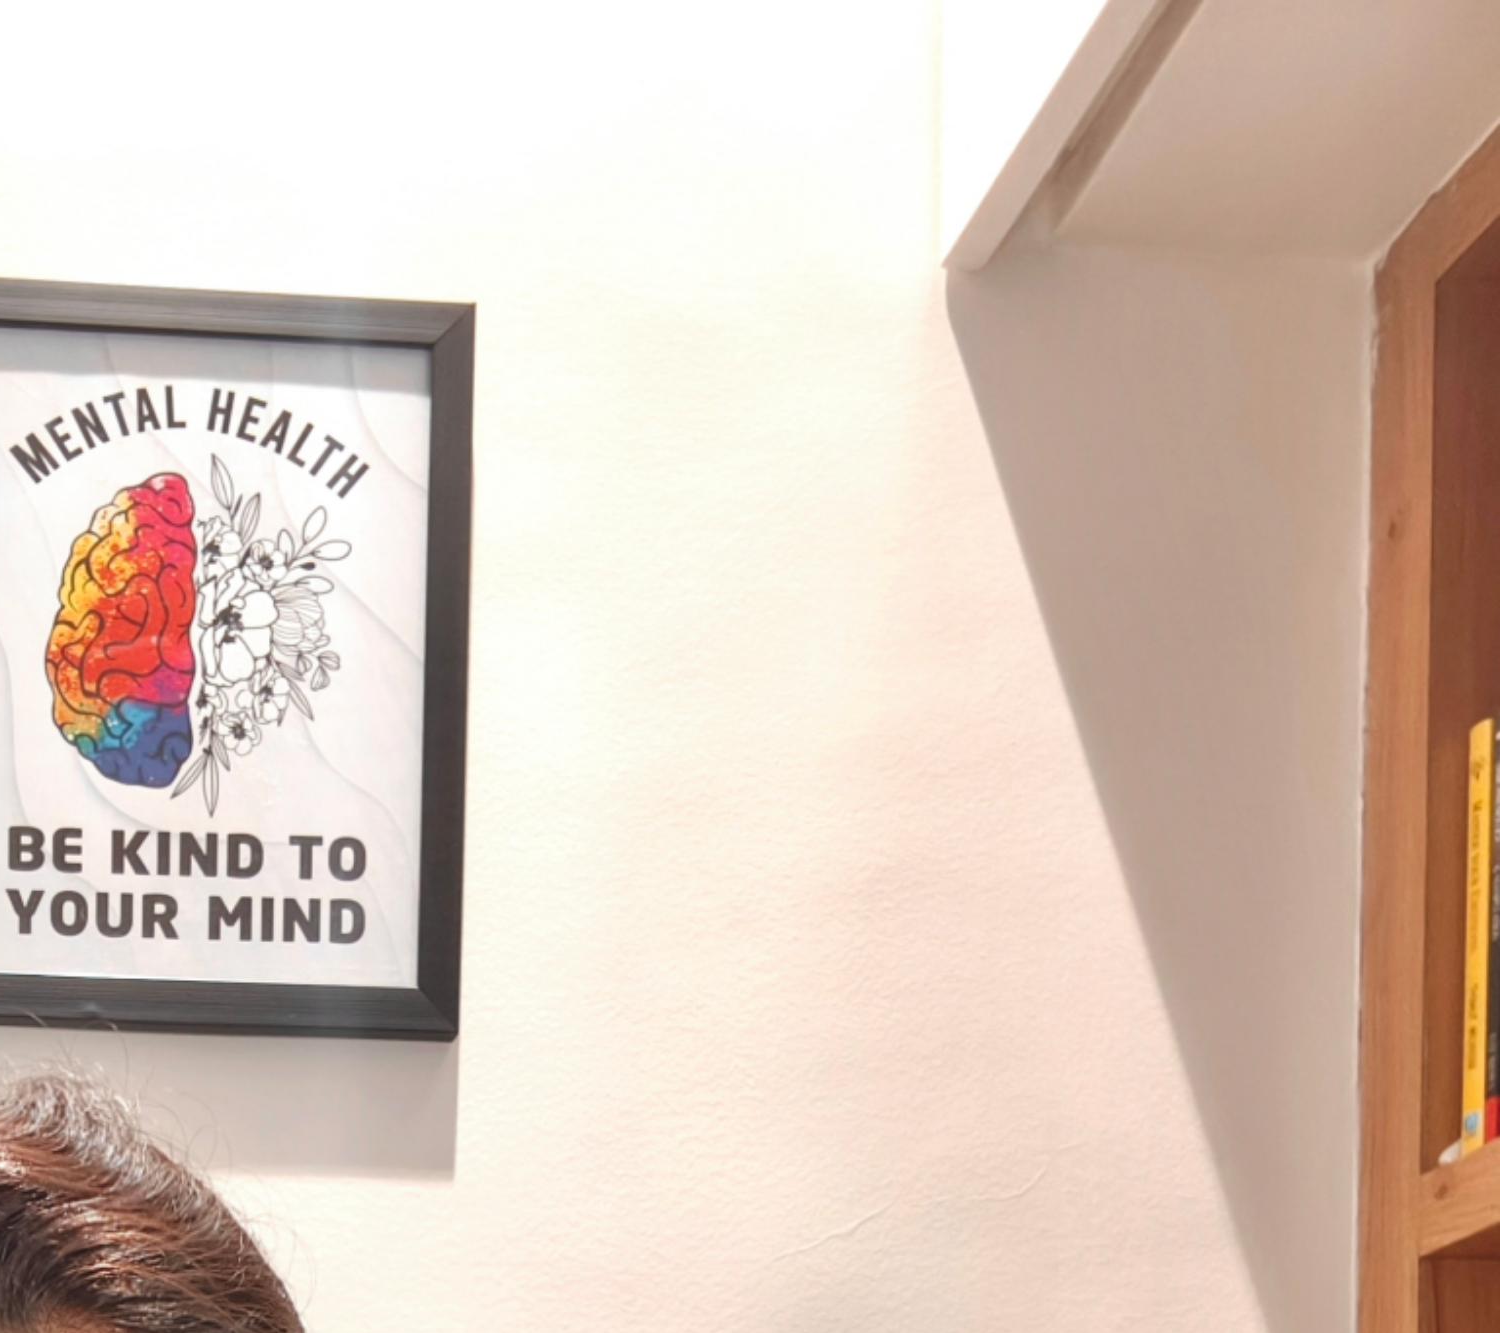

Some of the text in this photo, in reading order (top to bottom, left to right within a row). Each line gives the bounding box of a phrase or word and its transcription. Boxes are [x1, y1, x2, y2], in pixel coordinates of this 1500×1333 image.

[10, 385, 369, 498] MENTAL HEALTH
[8, 825, 367, 881] BE KIND TO
[6, 888, 367, 944] YOUR MIND
